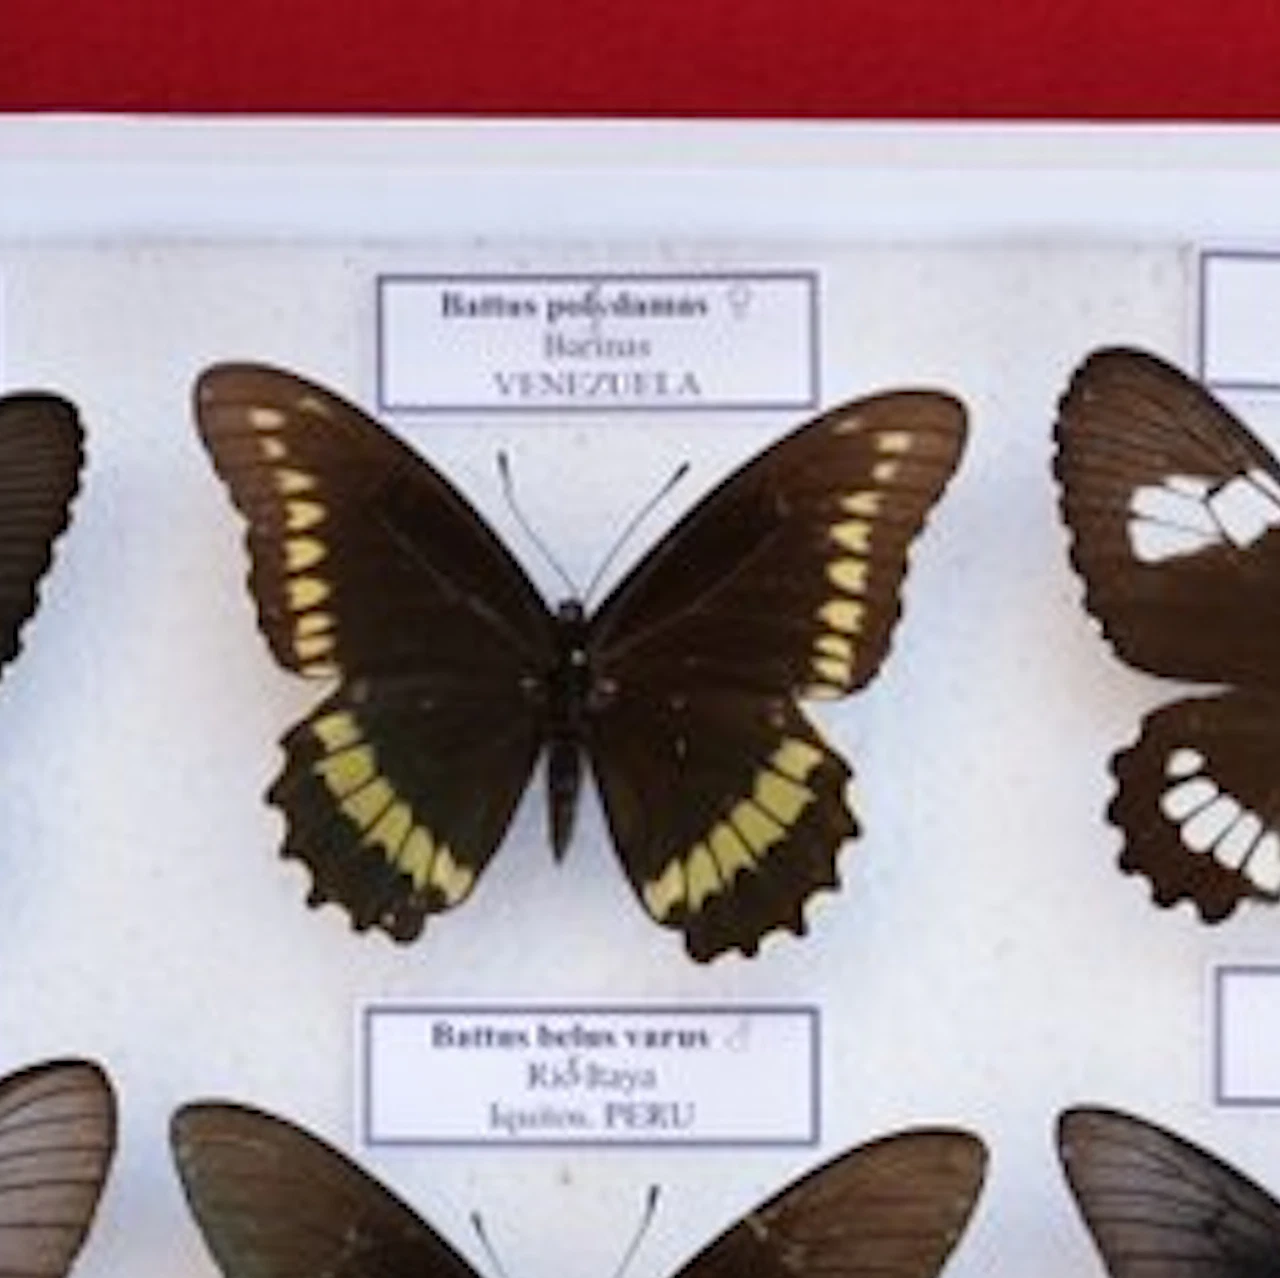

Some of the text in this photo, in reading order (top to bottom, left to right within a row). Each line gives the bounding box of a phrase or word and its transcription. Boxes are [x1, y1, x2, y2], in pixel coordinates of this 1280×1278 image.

[441, 291, 536, 318] Battus
[494, 371, 701, 396] VENEZUELA
[432, 1022, 526, 1049] Battus
[624, 1026, 710, 1049] varus
[605, 1103, 695, 1129] PERU
